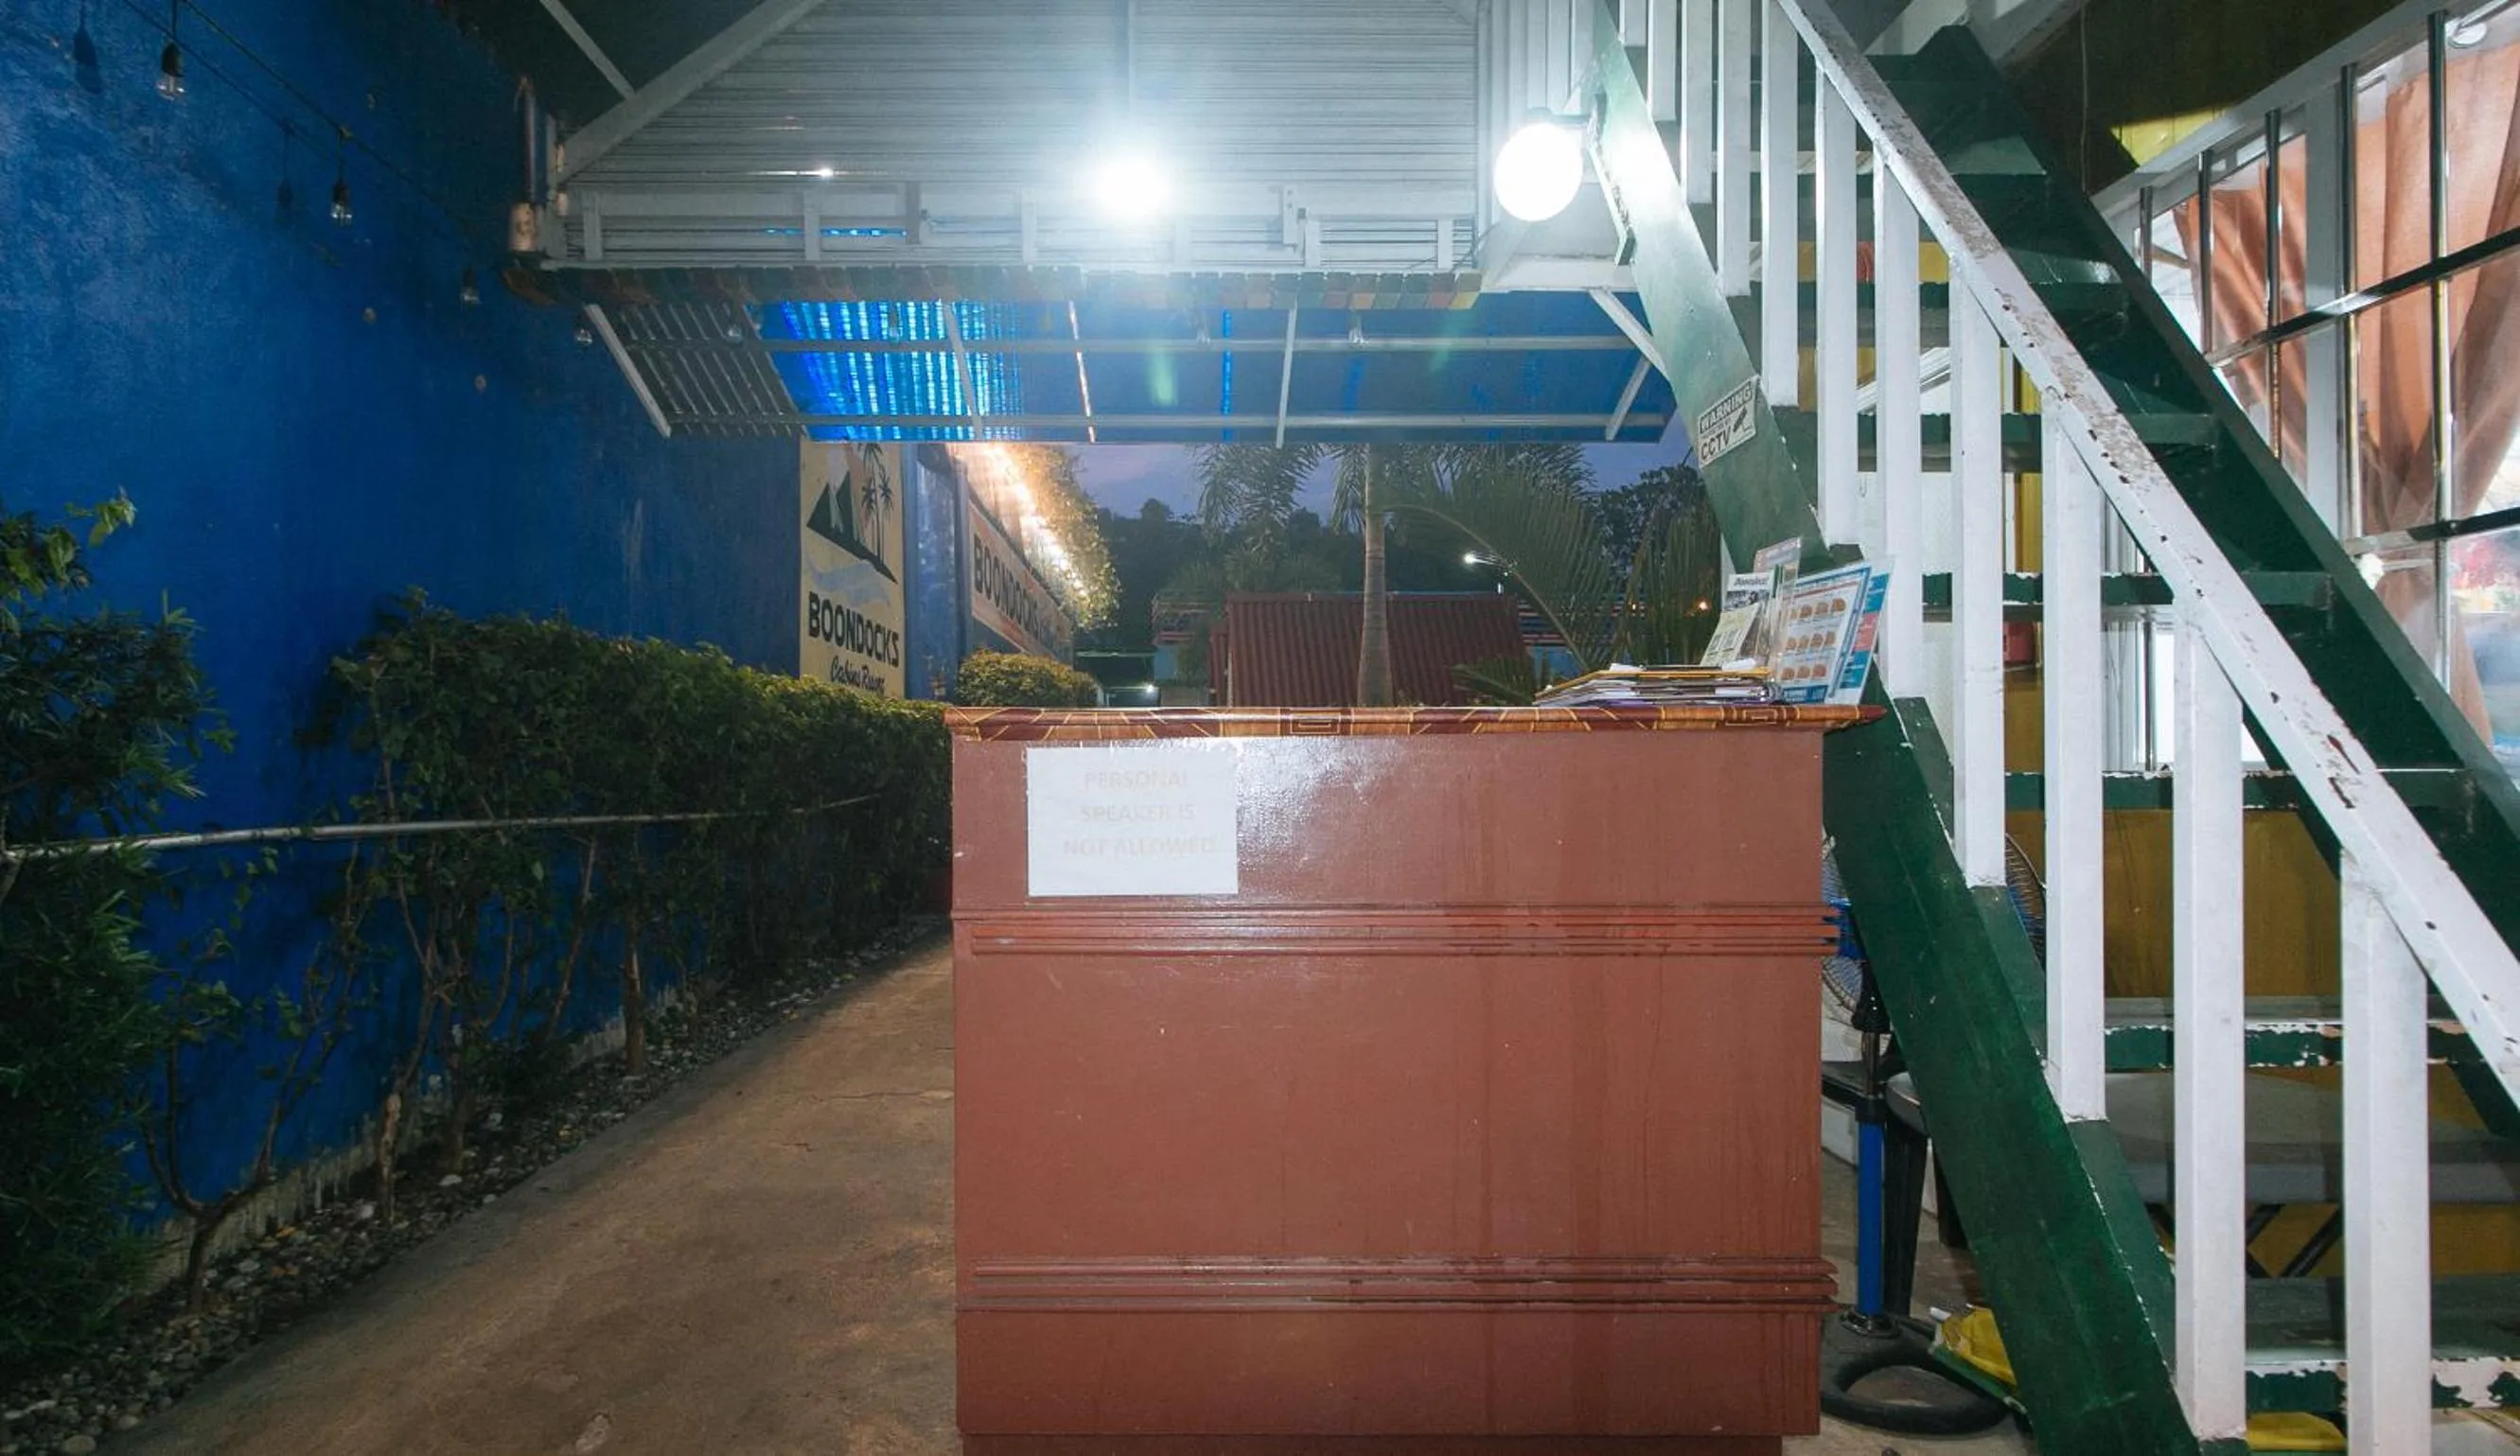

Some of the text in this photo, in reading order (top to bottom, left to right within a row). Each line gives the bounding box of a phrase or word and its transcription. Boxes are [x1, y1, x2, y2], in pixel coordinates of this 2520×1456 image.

[1701, 381, 1753, 433] WARNING
[1701, 425, 1732, 460] CCTV
[809, 591, 899, 668] BOONDOCKS
[1084, 768, 1189, 789] PERSONAL
[1081, 801, 1196, 822] SPEAKER IS
[1064, 835, 1217, 856] NOT ALLOWED
